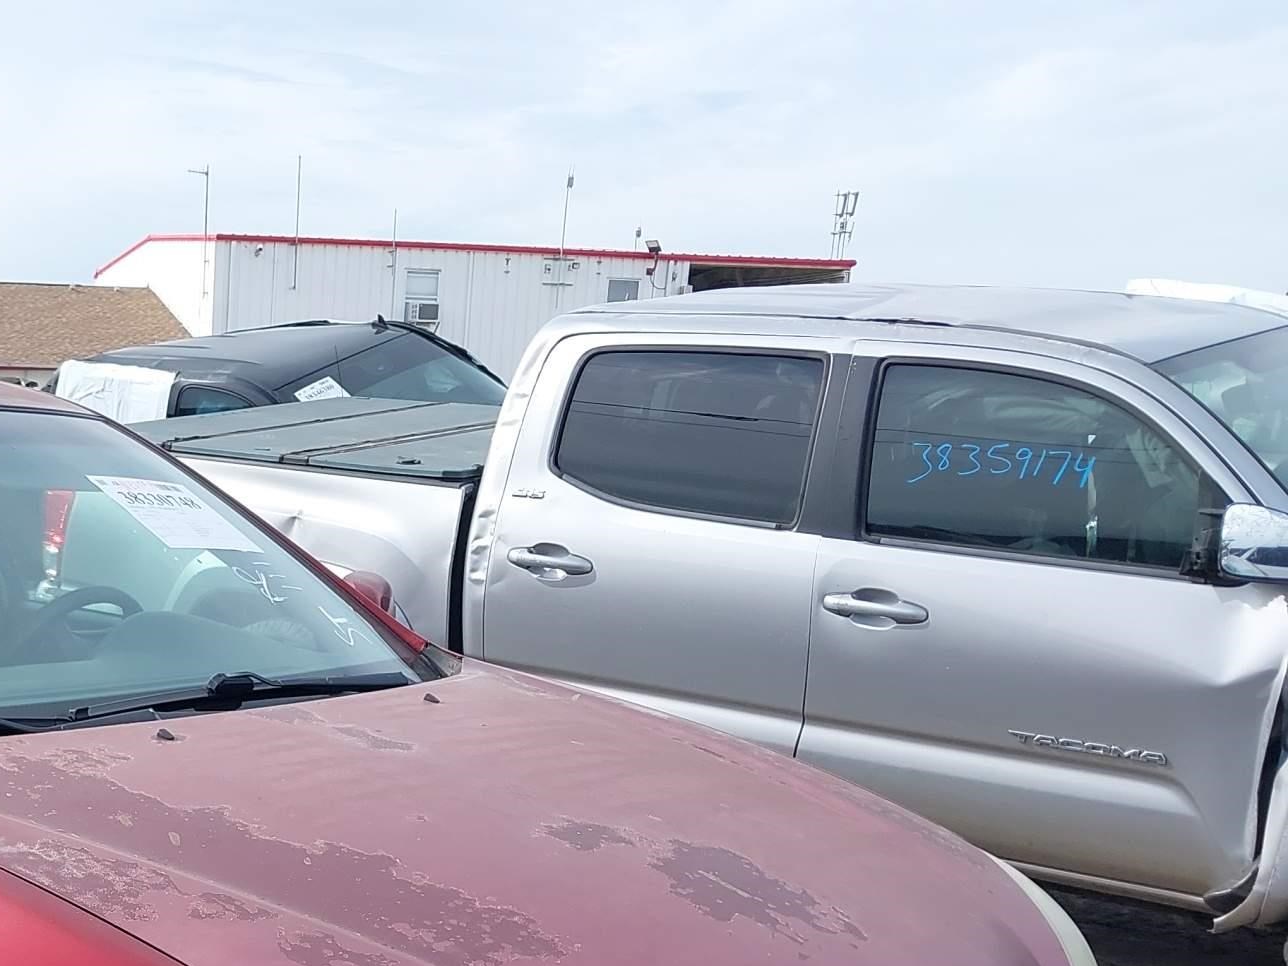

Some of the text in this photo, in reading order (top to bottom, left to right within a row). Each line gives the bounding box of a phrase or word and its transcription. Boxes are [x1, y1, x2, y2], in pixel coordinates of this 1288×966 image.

[907, 443, 1096, 488] 38359174
[117, 491, 202, 510] 38330748
[1008, 729, 1167, 765] TACOMA
